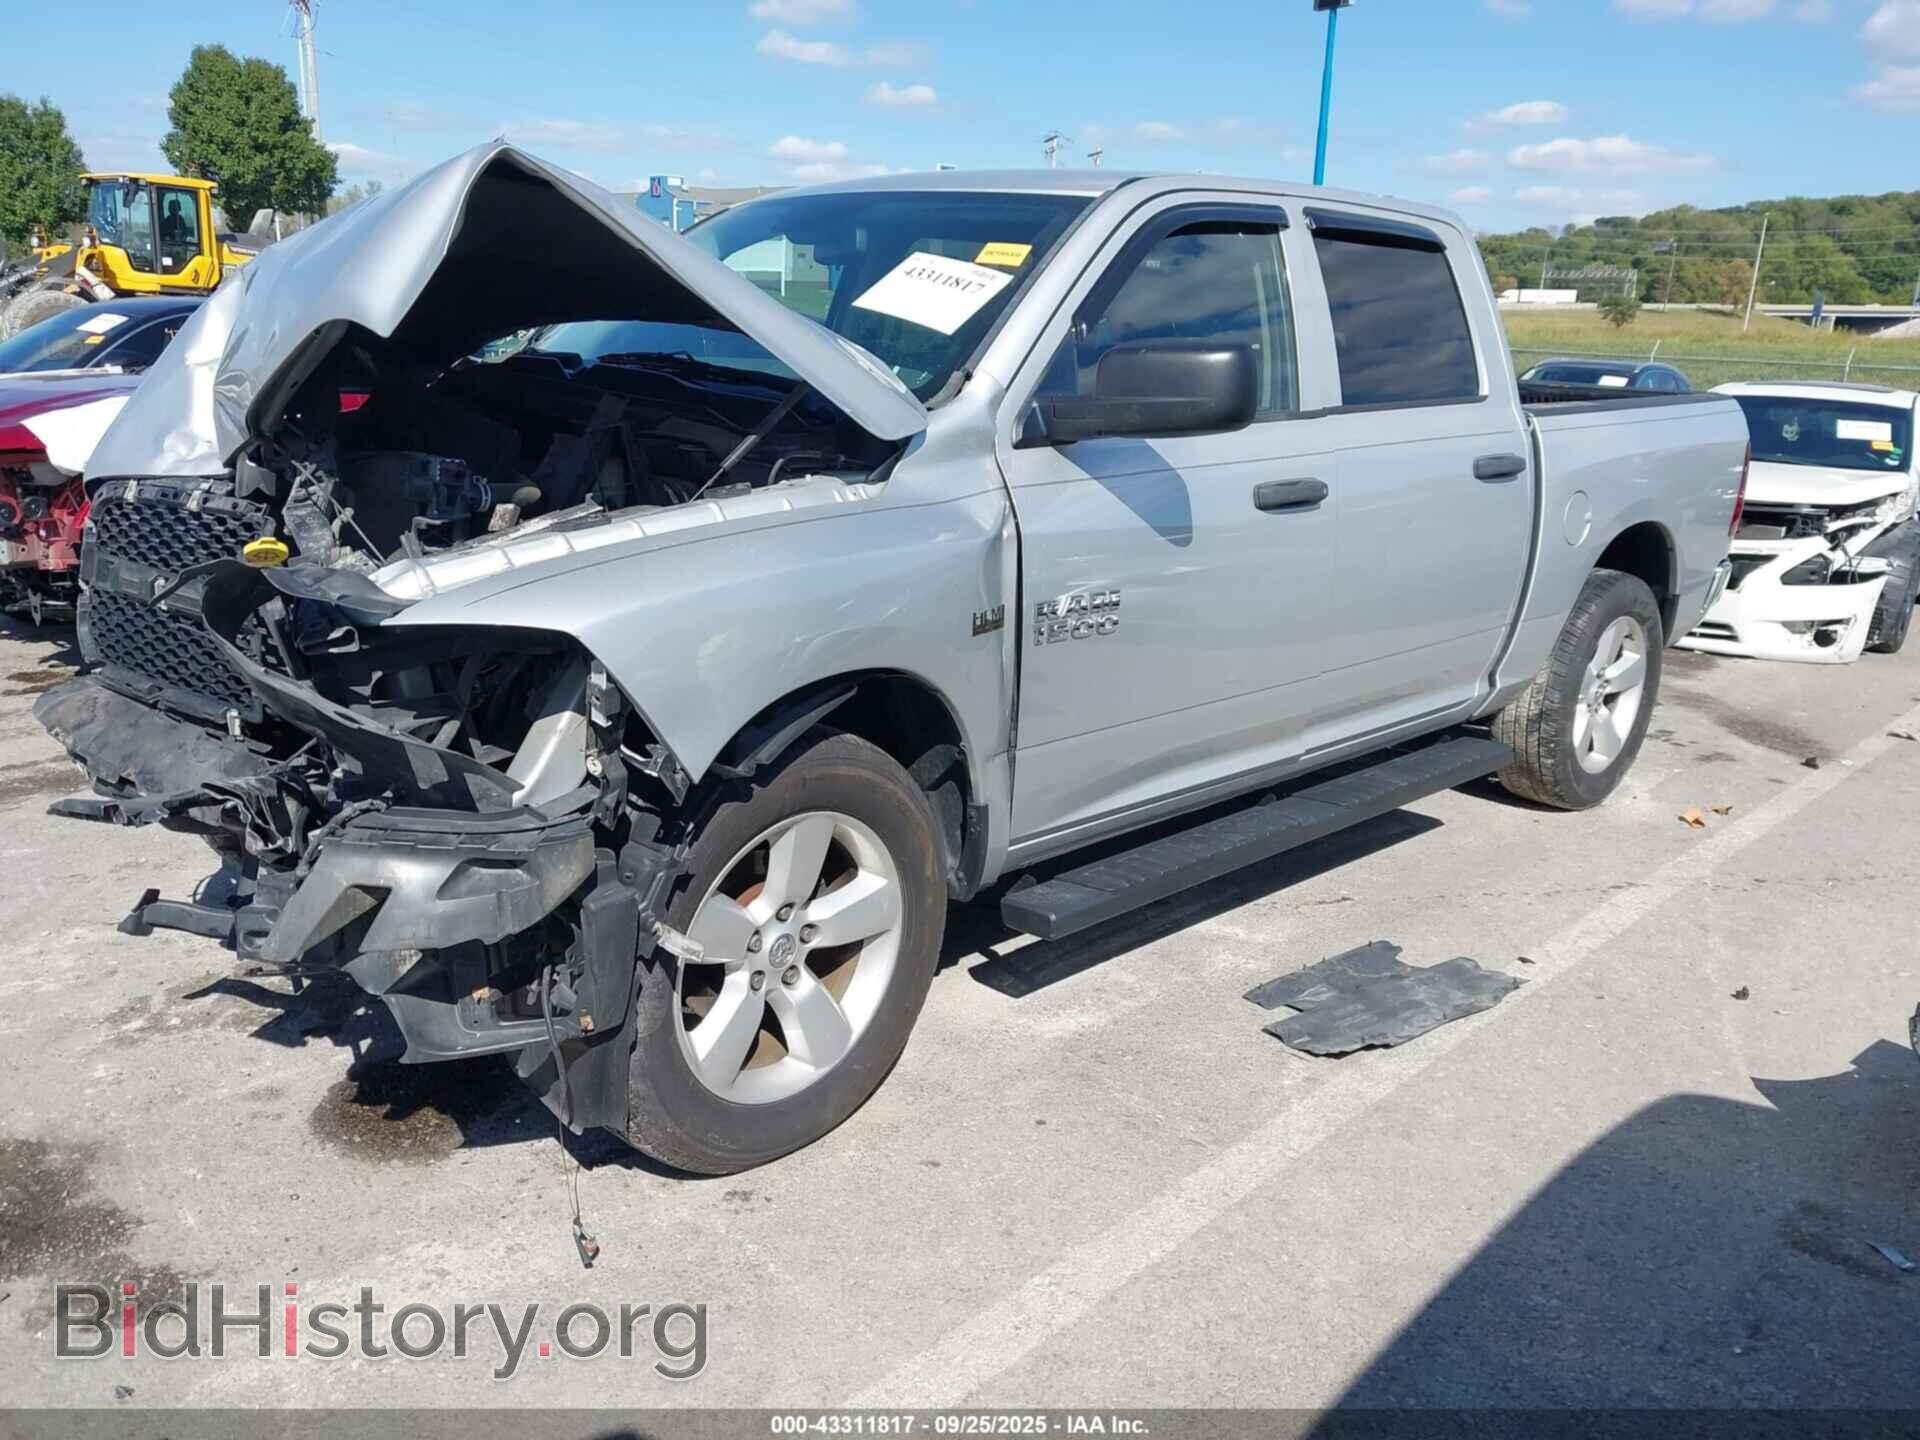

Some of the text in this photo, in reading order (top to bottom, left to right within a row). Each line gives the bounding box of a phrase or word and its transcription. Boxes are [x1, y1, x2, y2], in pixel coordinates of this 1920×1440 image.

[904, 266, 986, 294] 43311817
[1033, 590, 1121, 623] RAM
[1033, 614, 1120, 646] 1500
